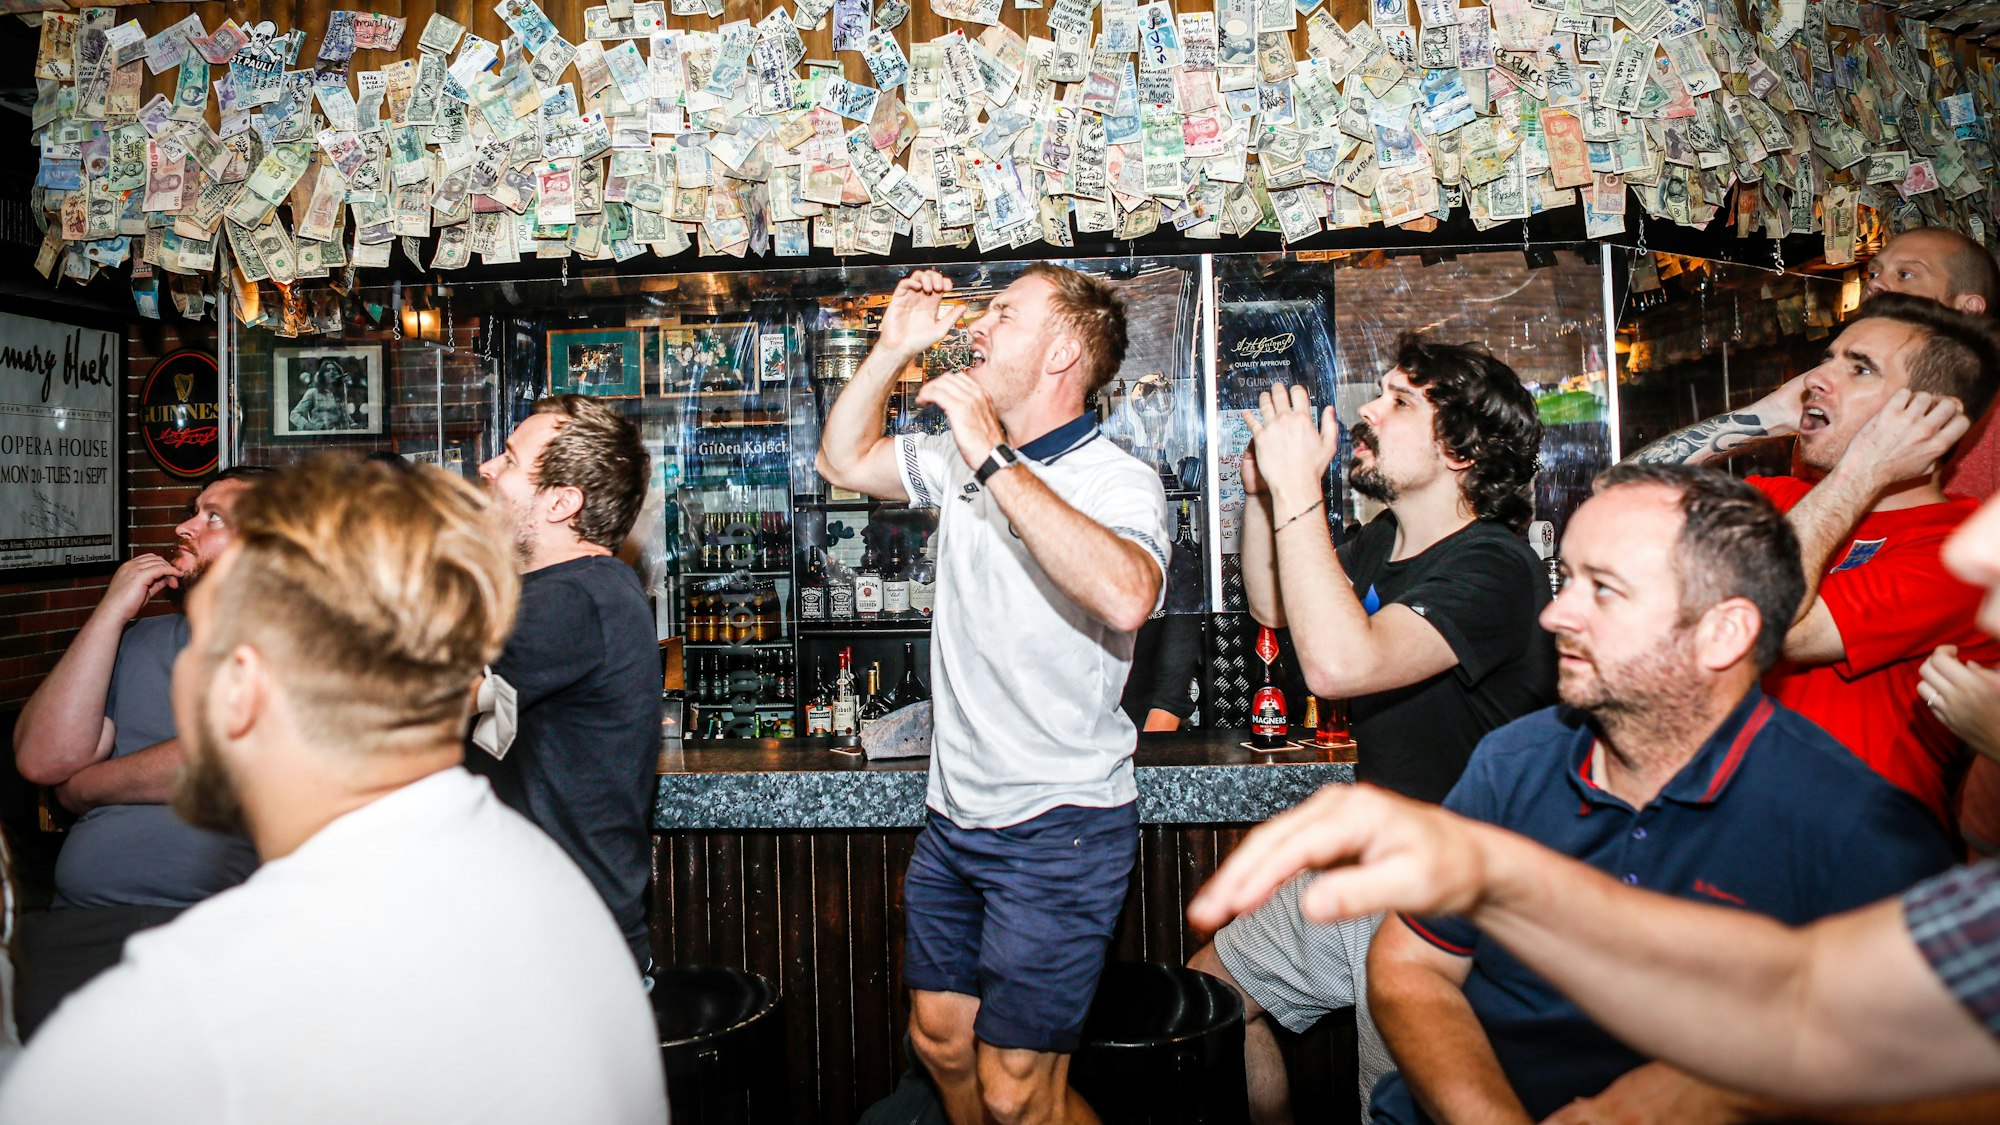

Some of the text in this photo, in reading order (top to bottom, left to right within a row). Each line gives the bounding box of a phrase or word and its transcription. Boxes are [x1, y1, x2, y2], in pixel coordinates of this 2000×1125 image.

[1427, 72, 1438, 81] 5
[1512, 55, 1544, 88] PLACE
[518, 224, 526, 240] 200
[915, 225, 923, 244] 2000
[63, 328, 112, 390] black
[1234, 359, 1291, 368] QUALITY APPROVED
[1, 435, 108, 458] OPERA HOUSE
[699, 440, 790, 457] Gilden Kölsch
[0, 465, 29, 484] MON
[74, 469, 83, 484] 21
[86, 467, 108, 484] SEPT
[1252, 714, 1286, 725] MAGNERS
